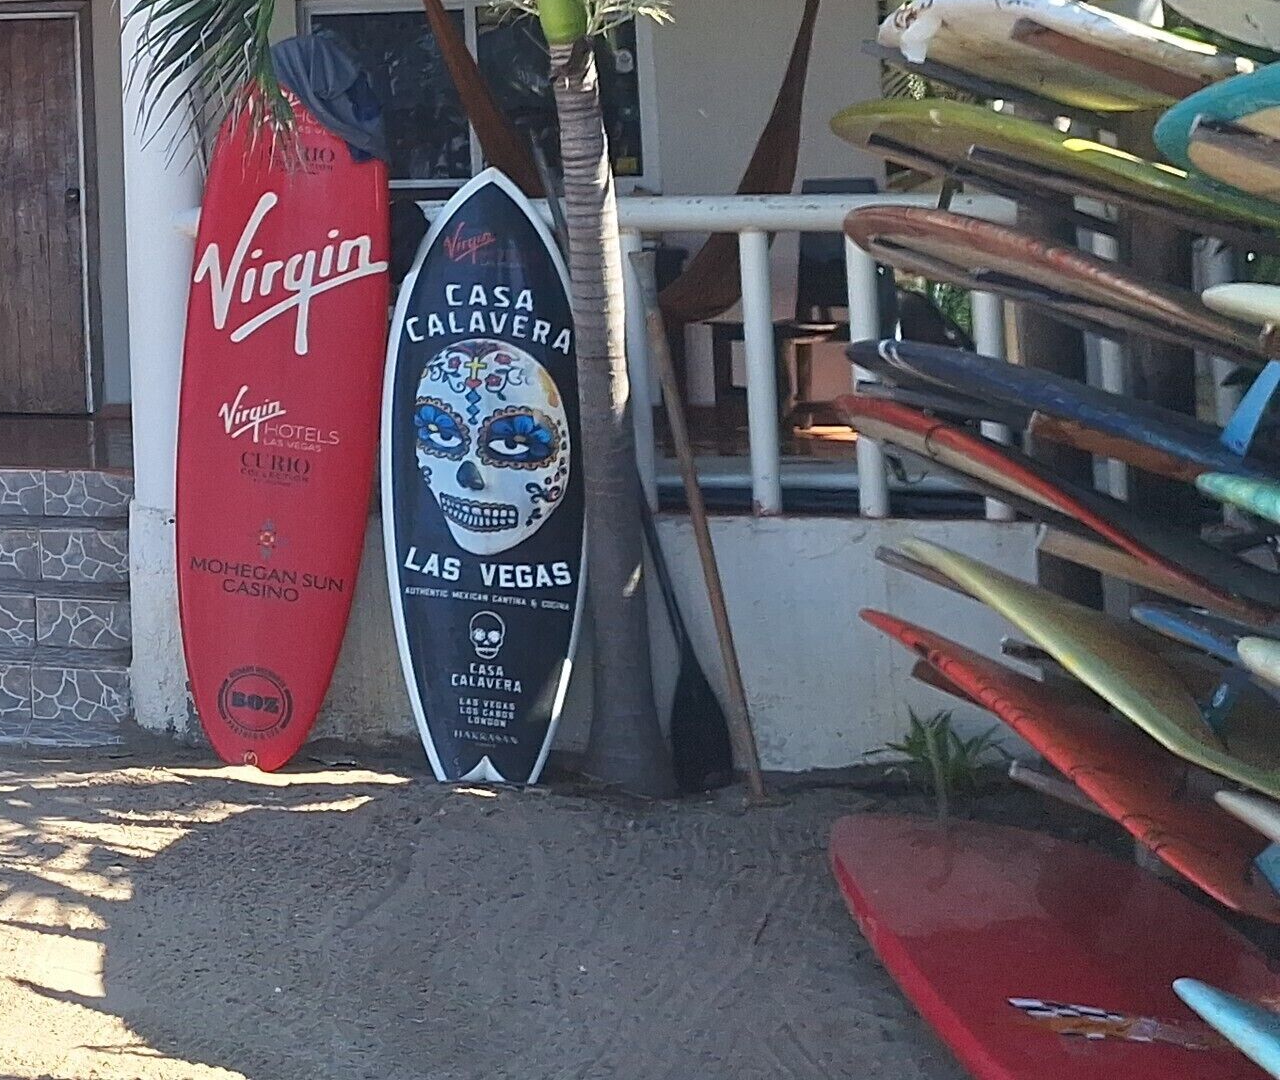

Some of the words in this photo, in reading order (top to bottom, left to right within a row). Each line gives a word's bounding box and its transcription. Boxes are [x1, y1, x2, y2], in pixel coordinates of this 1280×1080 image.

[443, 221, 496, 264] Virgin
[193, 191, 389, 356] Virgin
[445, 283, 534, 312] CASA
[405, 310, 572, 355] CALAVERA
[218, 385, 287, 443] Virgin
[264, 422, 340, 445] HOTELS
[263, 438, 284, 448] LAS
[287, 441, 322, 453] VEGAS
[241, 451, 310, 474] CURIO
[190, 556, 298, 584] MOHEGAN
[302, 573, 344, 592] SUN
[404, 546, 462, 581] LAS
[479, 562, 572, 588] VEGAS
[223, 578, 300, 602] CASINO
[404, 586, 449, 598] AUTHENTIC
[452, 591, 489, 602] MEXICAN
[492, 594, 527, 607] CANTINA
[469, 663, 504, 677] CASA
[451, 673, 522, 693] CALAVERA
[459, 697, 479, 707] LAS
[482, 700, 516, 711] VEGAS
[459, 706, 479, 716] LOS
[482, 709, 515, 720] CABOS
[468, 716, 507, 727] LONDON
